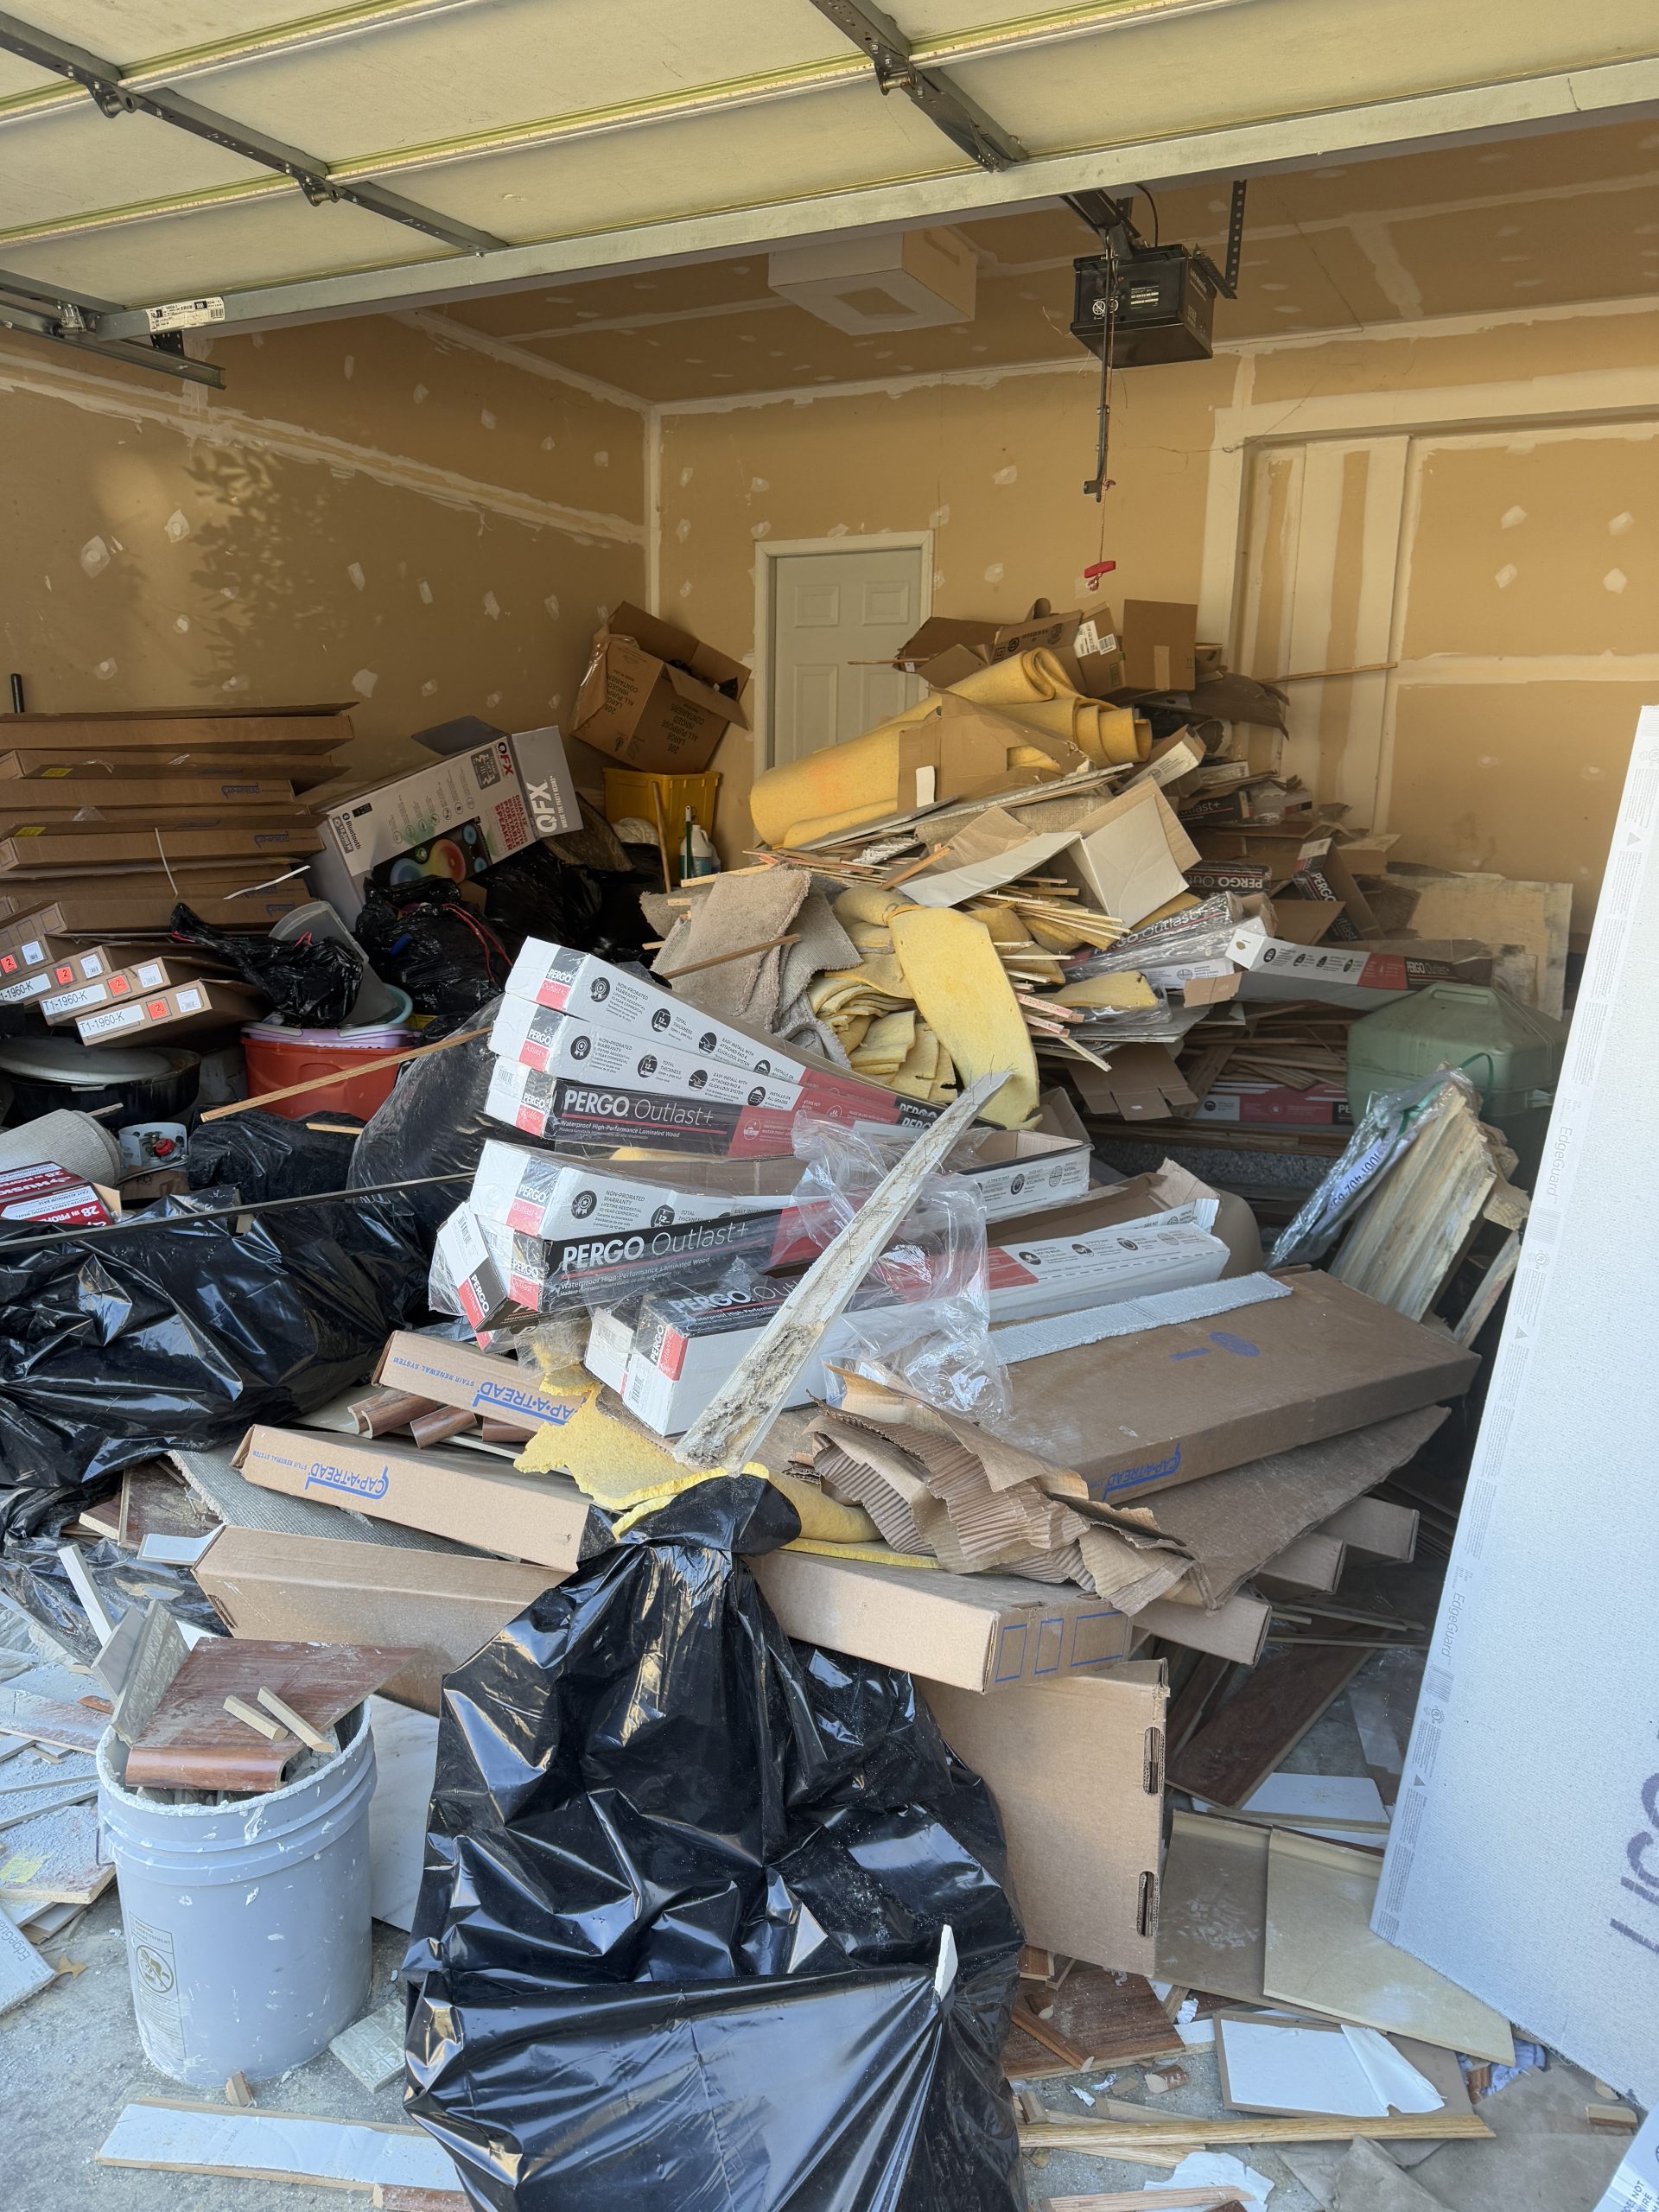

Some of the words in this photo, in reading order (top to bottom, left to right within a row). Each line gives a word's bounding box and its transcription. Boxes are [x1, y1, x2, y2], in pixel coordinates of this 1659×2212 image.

[607, 674, 639, 694] CONTAINER
[607, 696, 623, 709] LARG
[498, 741, 514, 776] QFX
[526, 782, 557, 832] QFX
[1180, 801, 1221, 816] utlast+
[346, 821, 361, 850] Bluetooth
[494, 804, 513, 851] SPEAKER
[1217, 876, 1264, 889] PERGO
[547, 968, 572, 983] PERGO
[1407, 961, 1426, 975] PERGO
[0, 981, 35, 1001] 1-1960-K
[615, 986, 639, 1001] WARRANTY
[43, 989, 88, 1012] T1-1960-K
[79, 1014, 125, 1033] T1-1960-K
[529, 1029, 551, 1046] PERGO
[597, 1043, 621, 1052] WARRANTY
[523, 1093, 546, 1108] PERGO
[563, 1090, 630, 1118] PERGO
[634, 1099, 715, 1127] Outlast+
[560, 1120, 592, 1130] Waterproof
[592, 1124, 639, 1135] High-Performance
[901, 1116, 934, 1129] PERG
[1547, 1126, 1573, 1198] EdgeGuard
[518, 1185, 547, 1203] PERGO
[603, 1197, 633, 1205] WARRANTY
[605, 1190, 645, 1202] NON-PRORATED
[81, 1205, 99, 1217] 28
[563, 1236, 645, 1272] PERGO
[652, 1221, 750, 1256] Outlast+
[511, 1262, 540, 1279] PERGO
[560, 1277, 601, 1290] Waterproof
[601, 1267, 659, 1284] High-Performance
[692, 1256, 711, 1266] Wood
[471, 1274, 490, 1313] PERGO
[668, 1290, 753, 1314] PERGO
[727, 1304, 782, 1319] High-Performanc
[650, 1325, 665, 1363] PERGO
[393, 1356, 420, 1371] SYSTEM
[421, 1364, 455, 1382] RENEWAL
[454, 1376, 476, 1388] STAIR
[252, 1451, 270, 1461] SYSTEM
[271, 1454, 294, 1467] RENEWAL
[293, 1461, 308, 1471] STAIR
[1440, 1592, 1465, 1661] EdgeGuard
[1631, 2179, 1645, 2200] NOT
